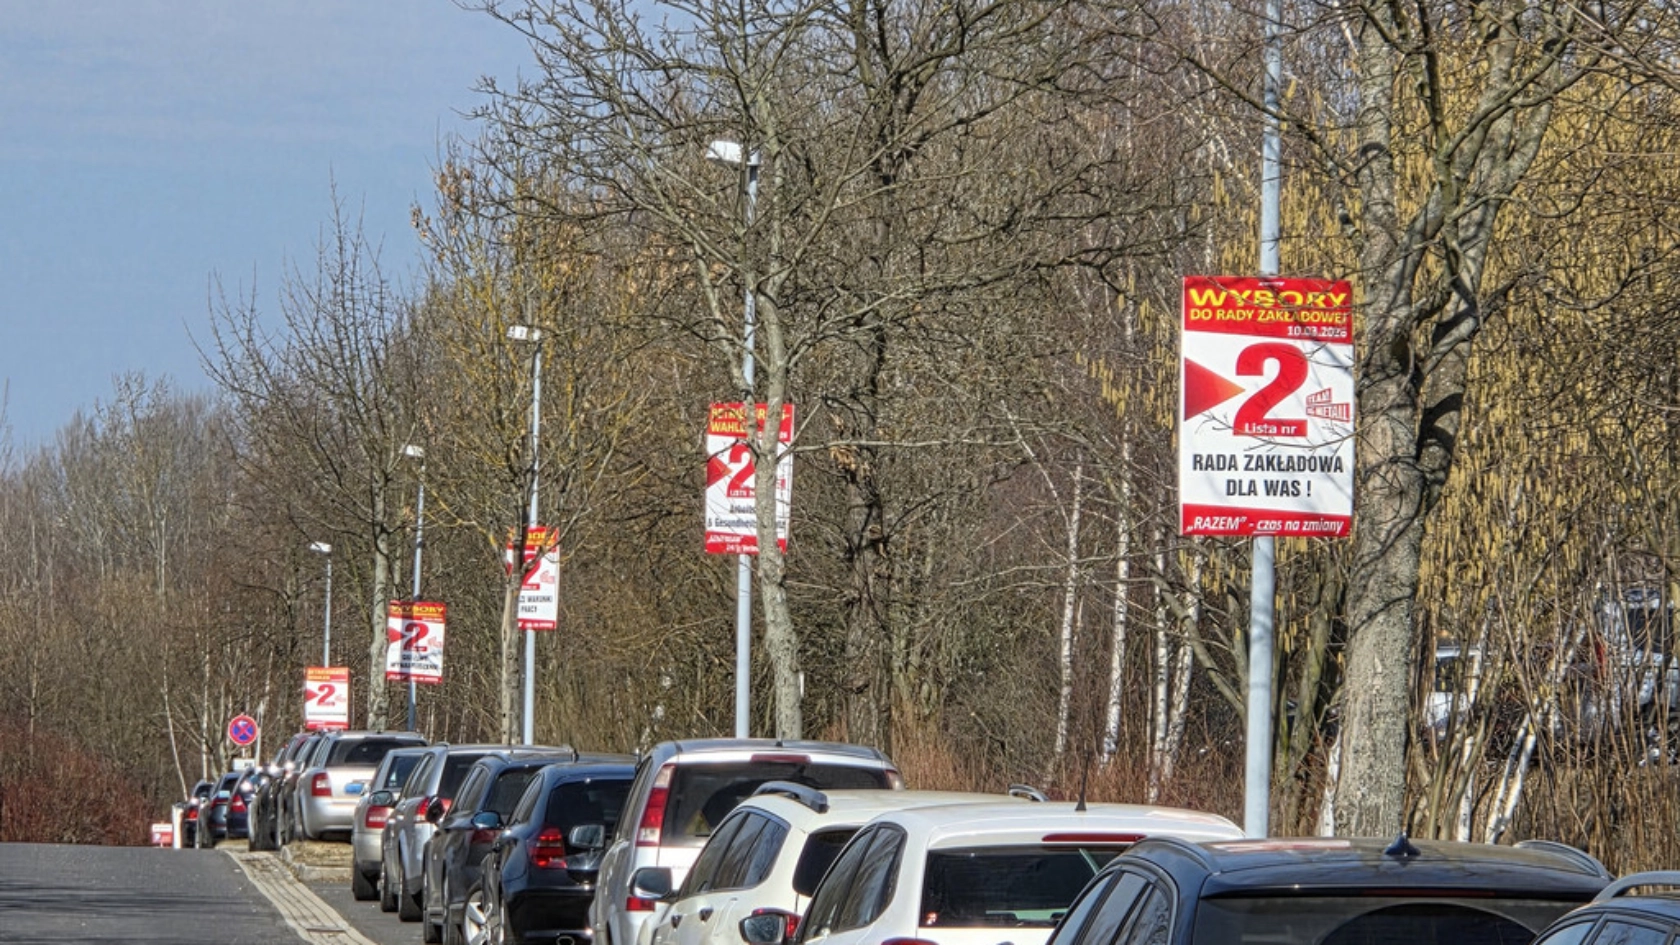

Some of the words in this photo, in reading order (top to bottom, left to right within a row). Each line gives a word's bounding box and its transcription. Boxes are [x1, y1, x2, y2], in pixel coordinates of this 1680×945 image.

[1189, 288, 1347, 308] WYBORY
[1190, 309, 1212, 321] DO
[1216, 309, 1255, 321] RADY
[1234, 341, 1309, 437] 2
[1244, 422, 1277, 435] Lista
[1281, 425, 1297, 435] nr
[726, 443, 756, 497] 2
[1192, 453, 1238, 472] RADA
[1243, 453, 1344, 473] ZAKŁADOWA
[1226, 479, 1257, 497] DLA
[1264, 480, 1301, 498] WAS
[1306, 480, 1312, 497] !
[1256, 518, 1283, 532] czas
[1284, 519, 1301, 531] na
[1302, 517, 1344, 534] zmiany
[403, 622, 429, 652] 2
[317, 684, 336, 707] 2
